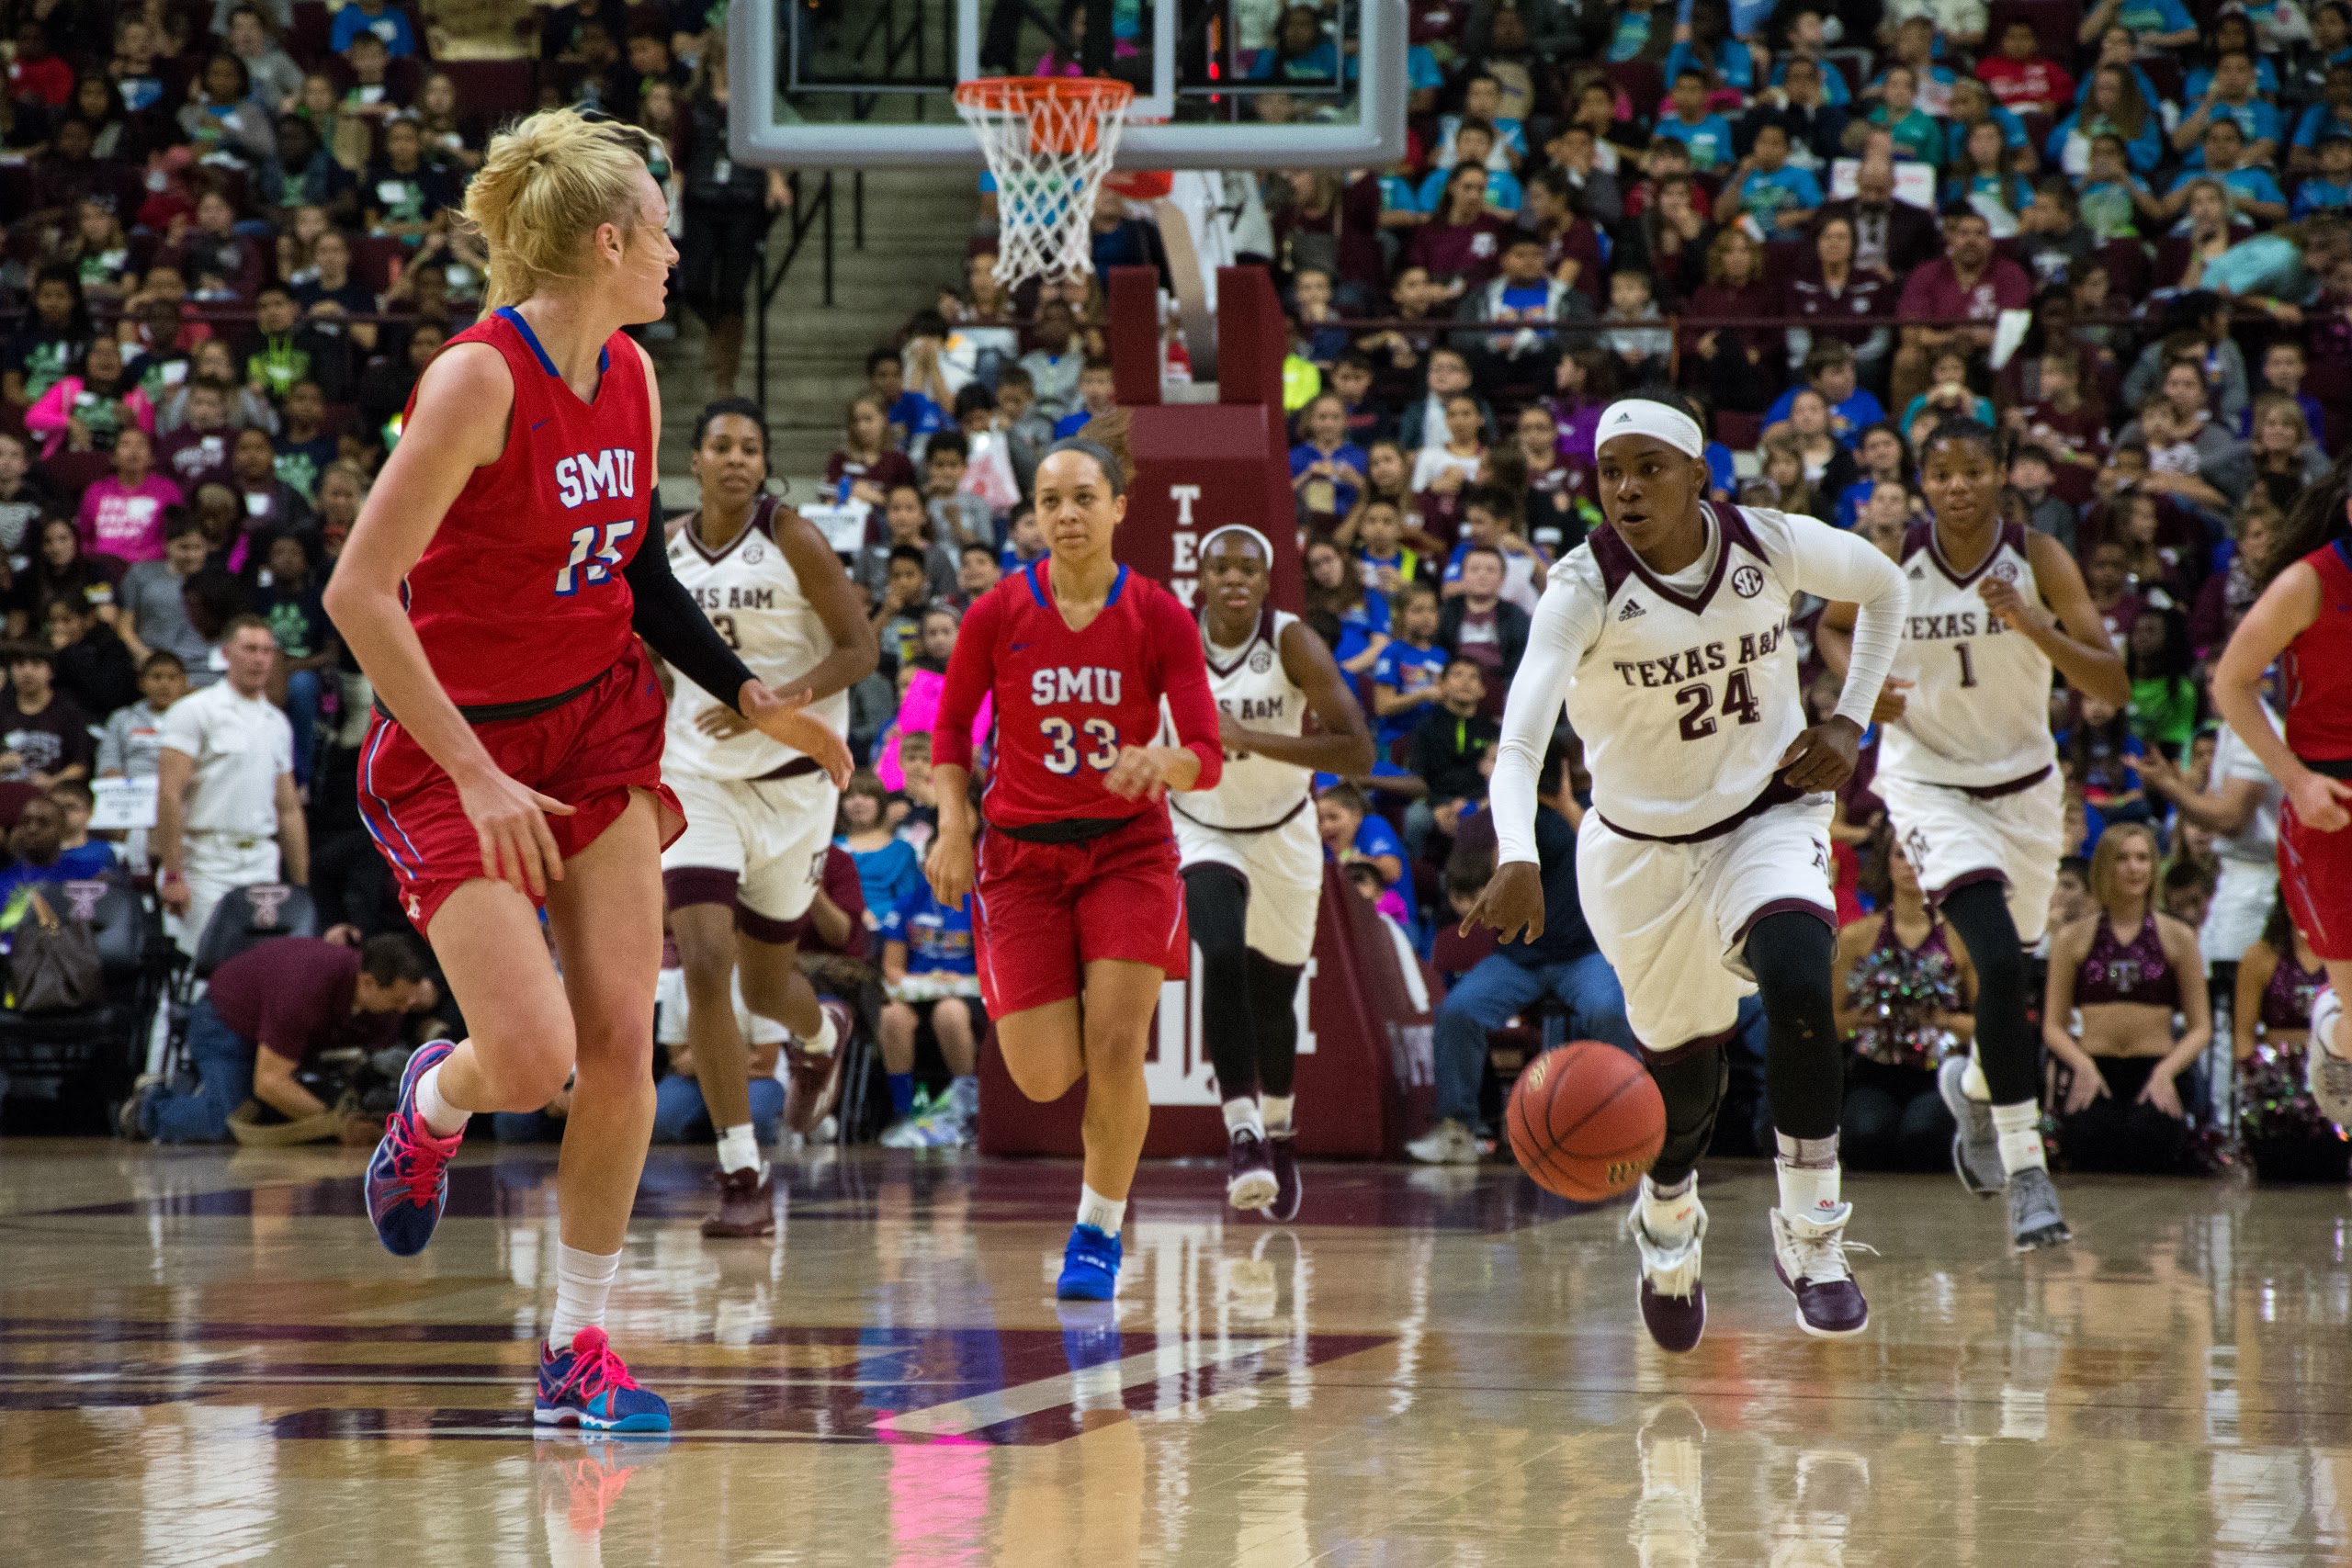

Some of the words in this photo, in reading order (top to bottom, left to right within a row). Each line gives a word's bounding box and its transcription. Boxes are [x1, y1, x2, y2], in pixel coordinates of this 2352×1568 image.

[555, 448, 635, 509] SMU
[555, 518, 637, 597] 15
[729, 587, 774, 610] A&M
[1618, 608, 1647, 622] adidas
[1613, 641, 1726, 687] TEXAS
[1738, 615, 1785, 664] A&M
[1953, 641, 1977, 688] 1
[1031, 666, 1122, 706] SMU
[1675, 667, 1761, 741] 24
[1039, 716, 1120, 777] 33
